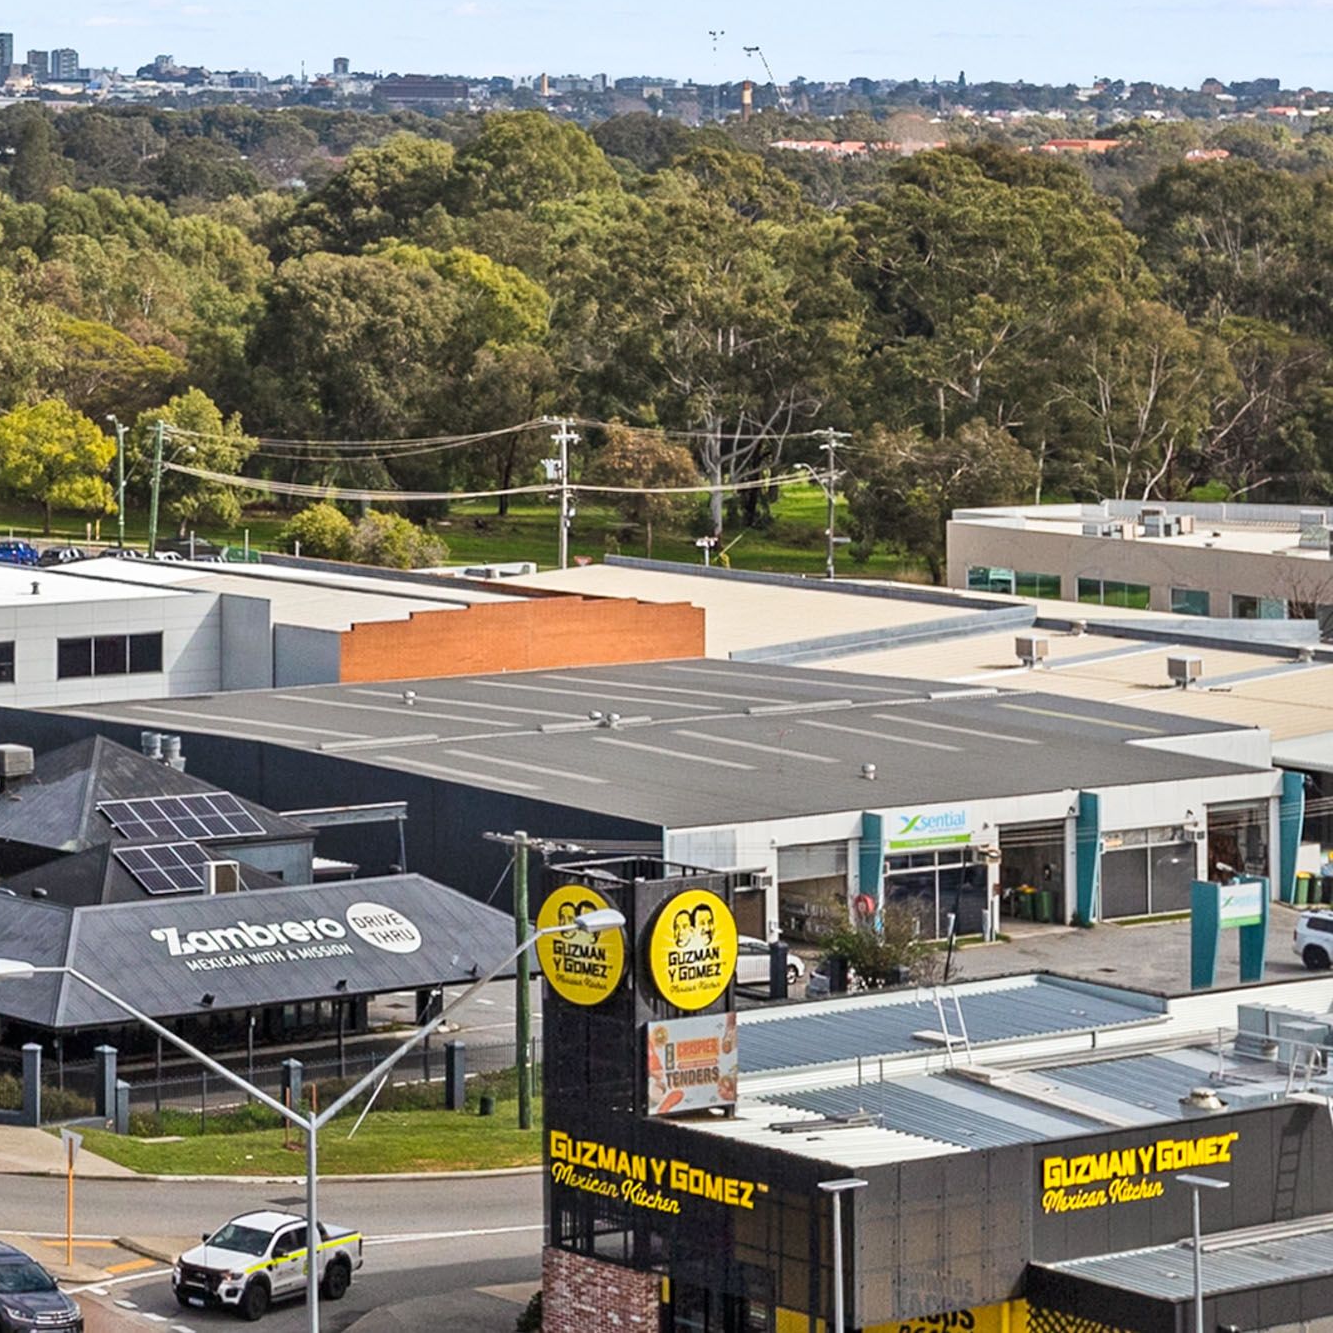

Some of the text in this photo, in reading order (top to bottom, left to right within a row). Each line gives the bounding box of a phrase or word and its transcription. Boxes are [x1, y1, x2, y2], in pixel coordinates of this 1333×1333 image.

[150, 912, 403, 957] Zambrero DRIVE
[368, 927, 415, 944] THRU
[185, 943, 355, 972] MEXICAN WITH A MISSION
[552, 939, 607, 962] GUZMAN
[668, 947, 720, 967] GUZMAN
[553, 957, 608, 979] Y GOMEZ
[668, 963, 722, 983] Y GOMEZ
[666, 1066, 720, 1089] TENDERS
[550, 1130, 647, 1182] GUZMAN
[650, 1157, 666, 1185] Y
[670, 1160, 755, 1209] GOMEZ
[1043, 1135, 1232, 1189] GUZMAN Y GOMEZ
[551, 1162, 681, 1214] Mexican Kitchen
[1042, 1177, 1164, 1214] Mexican Kitchen
